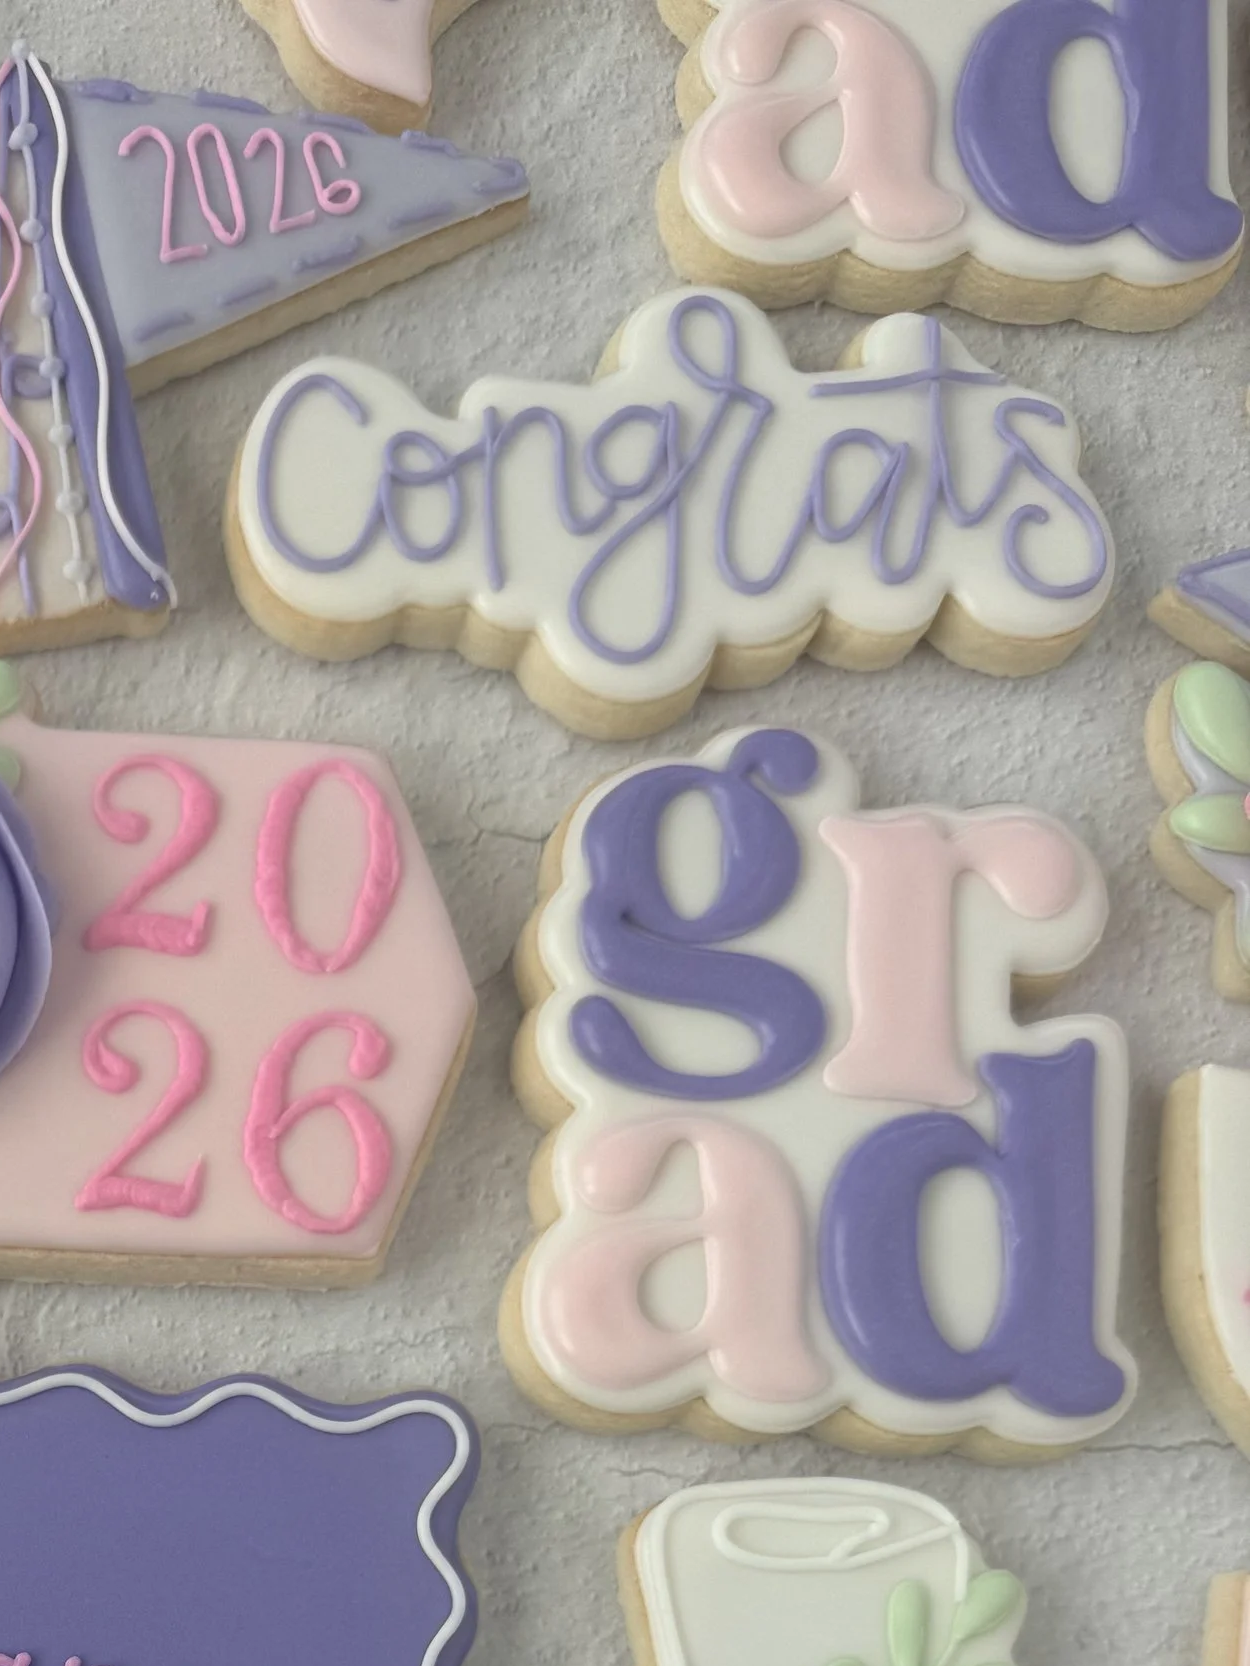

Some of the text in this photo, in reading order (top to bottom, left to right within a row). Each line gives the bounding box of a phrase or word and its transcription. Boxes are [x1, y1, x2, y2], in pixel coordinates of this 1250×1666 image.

[118, 122, 362, 263] 2026
[695, 0, 1244, 262] ad
[256, 295, 1108, 665] Congrats
[83, 753, 402, 975] 20
[580, 728, 1080, 1107] gr
[74, 998, 394, 1236] 26
[548, 1036, 1126, 1418] ad
